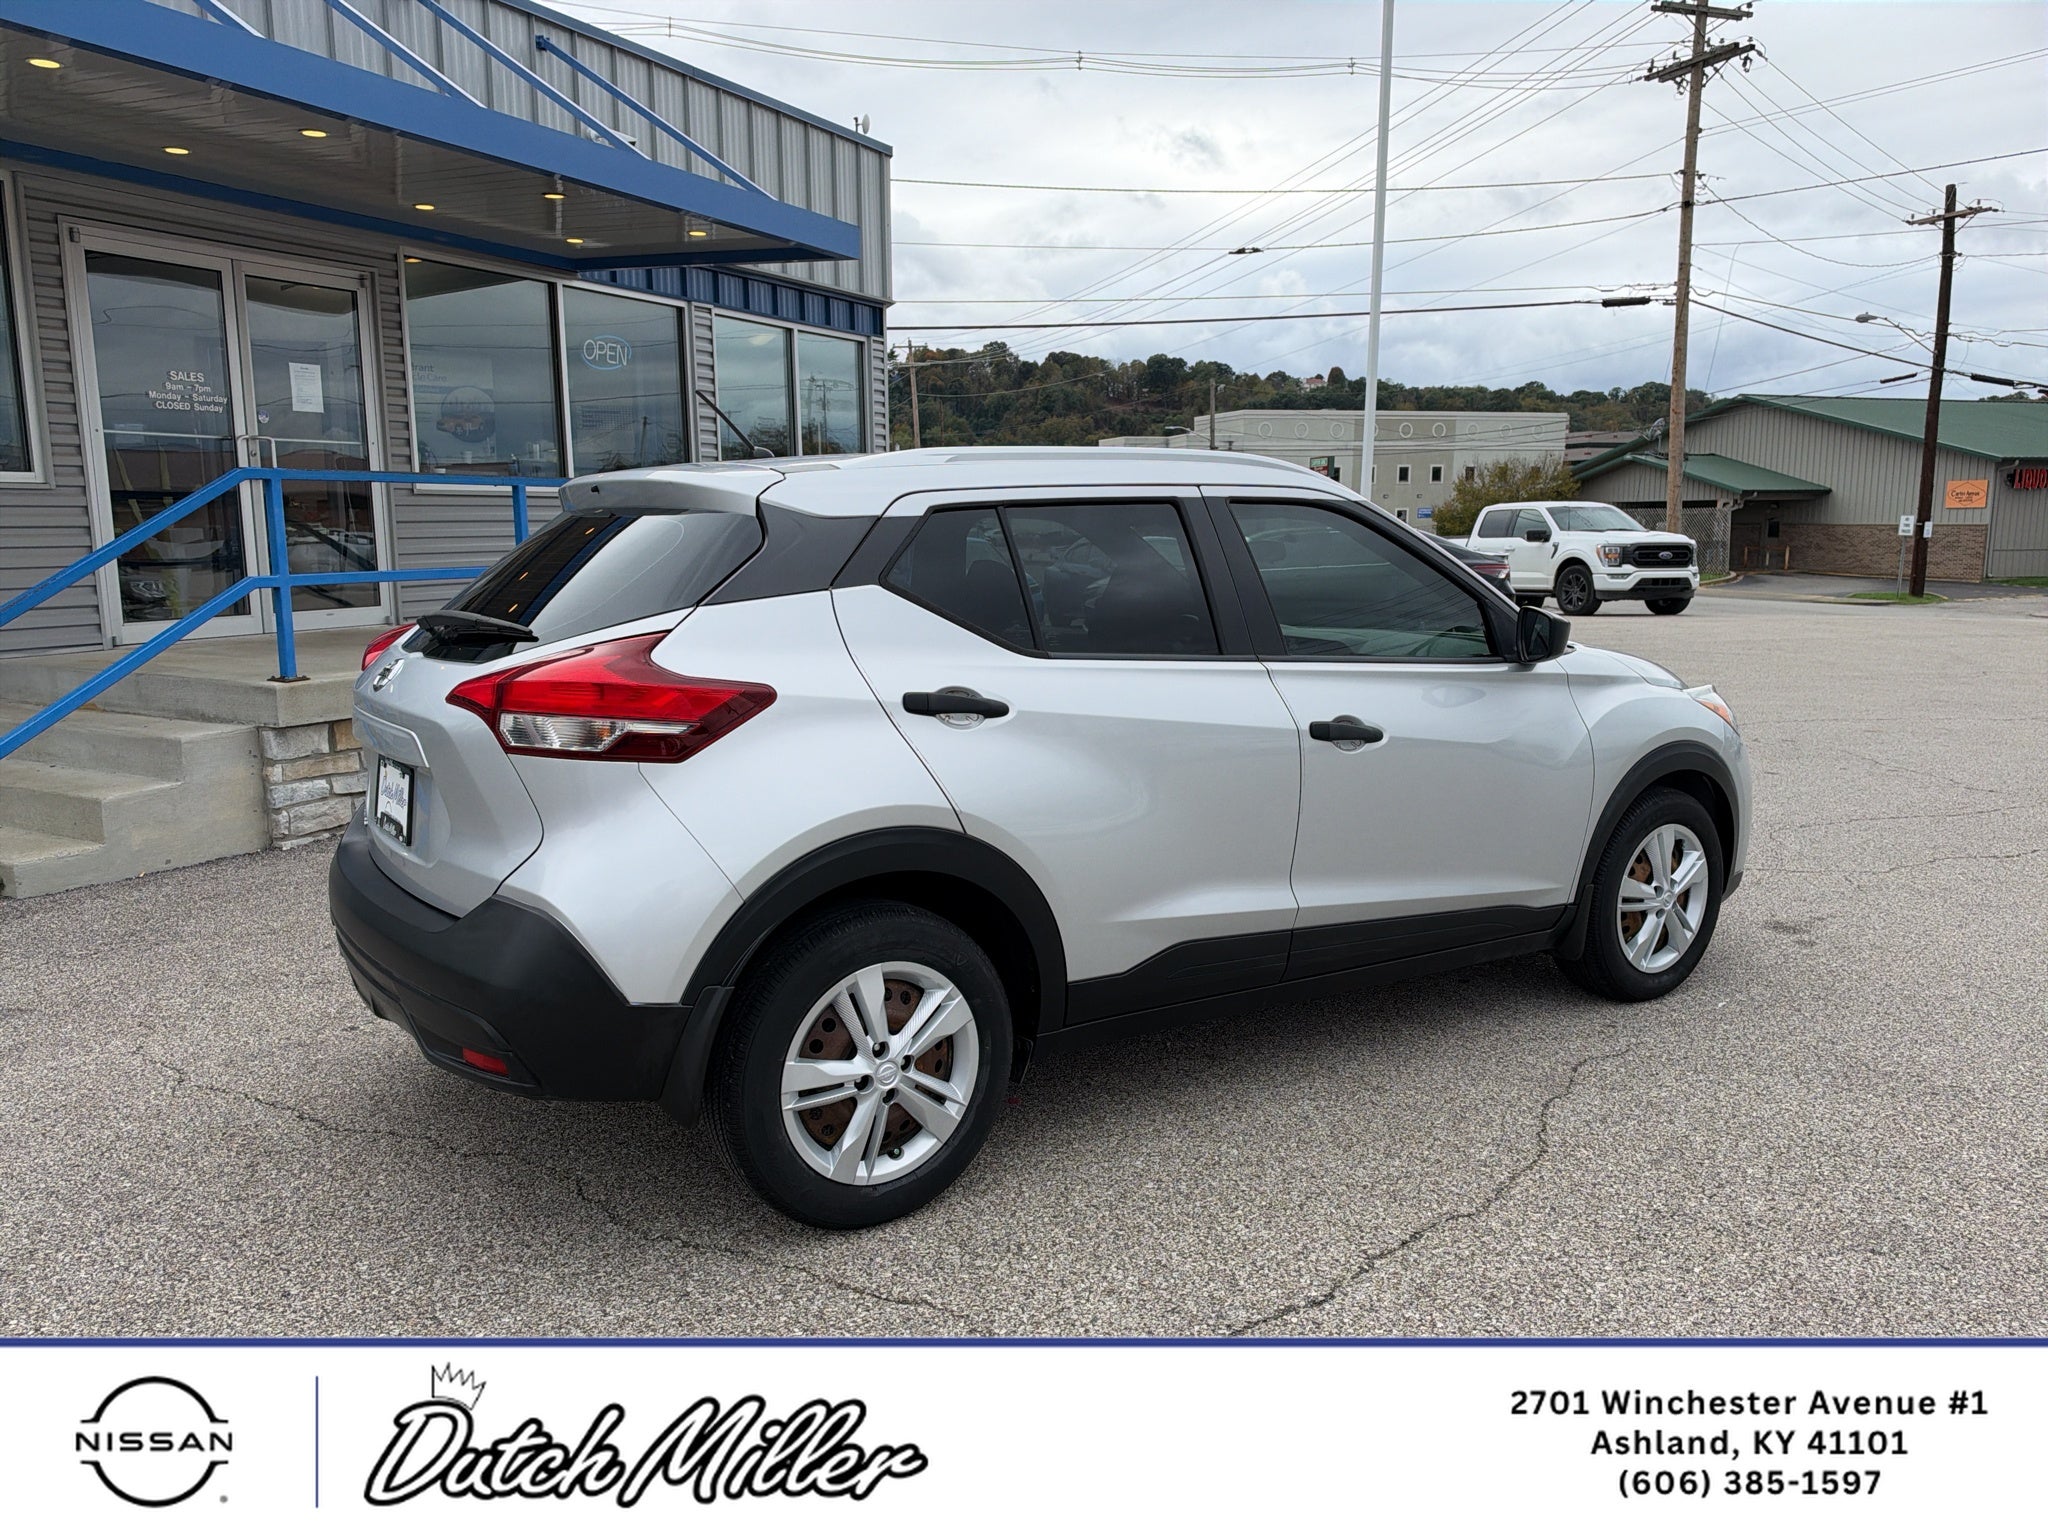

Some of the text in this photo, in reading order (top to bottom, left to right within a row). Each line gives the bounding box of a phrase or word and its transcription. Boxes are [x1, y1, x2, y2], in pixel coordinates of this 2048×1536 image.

[583, 339, 628, 366] OPEN
[169, 370, 205, 382] SALES
[165, 382, 184, 391] 9am
[194, 384, 211, 393] 7pm
[148, 390, 181, 401] Monday
[192, 393, 228, 404] Saturday
[155, 400, 223, 413] CLOSED Sunday
